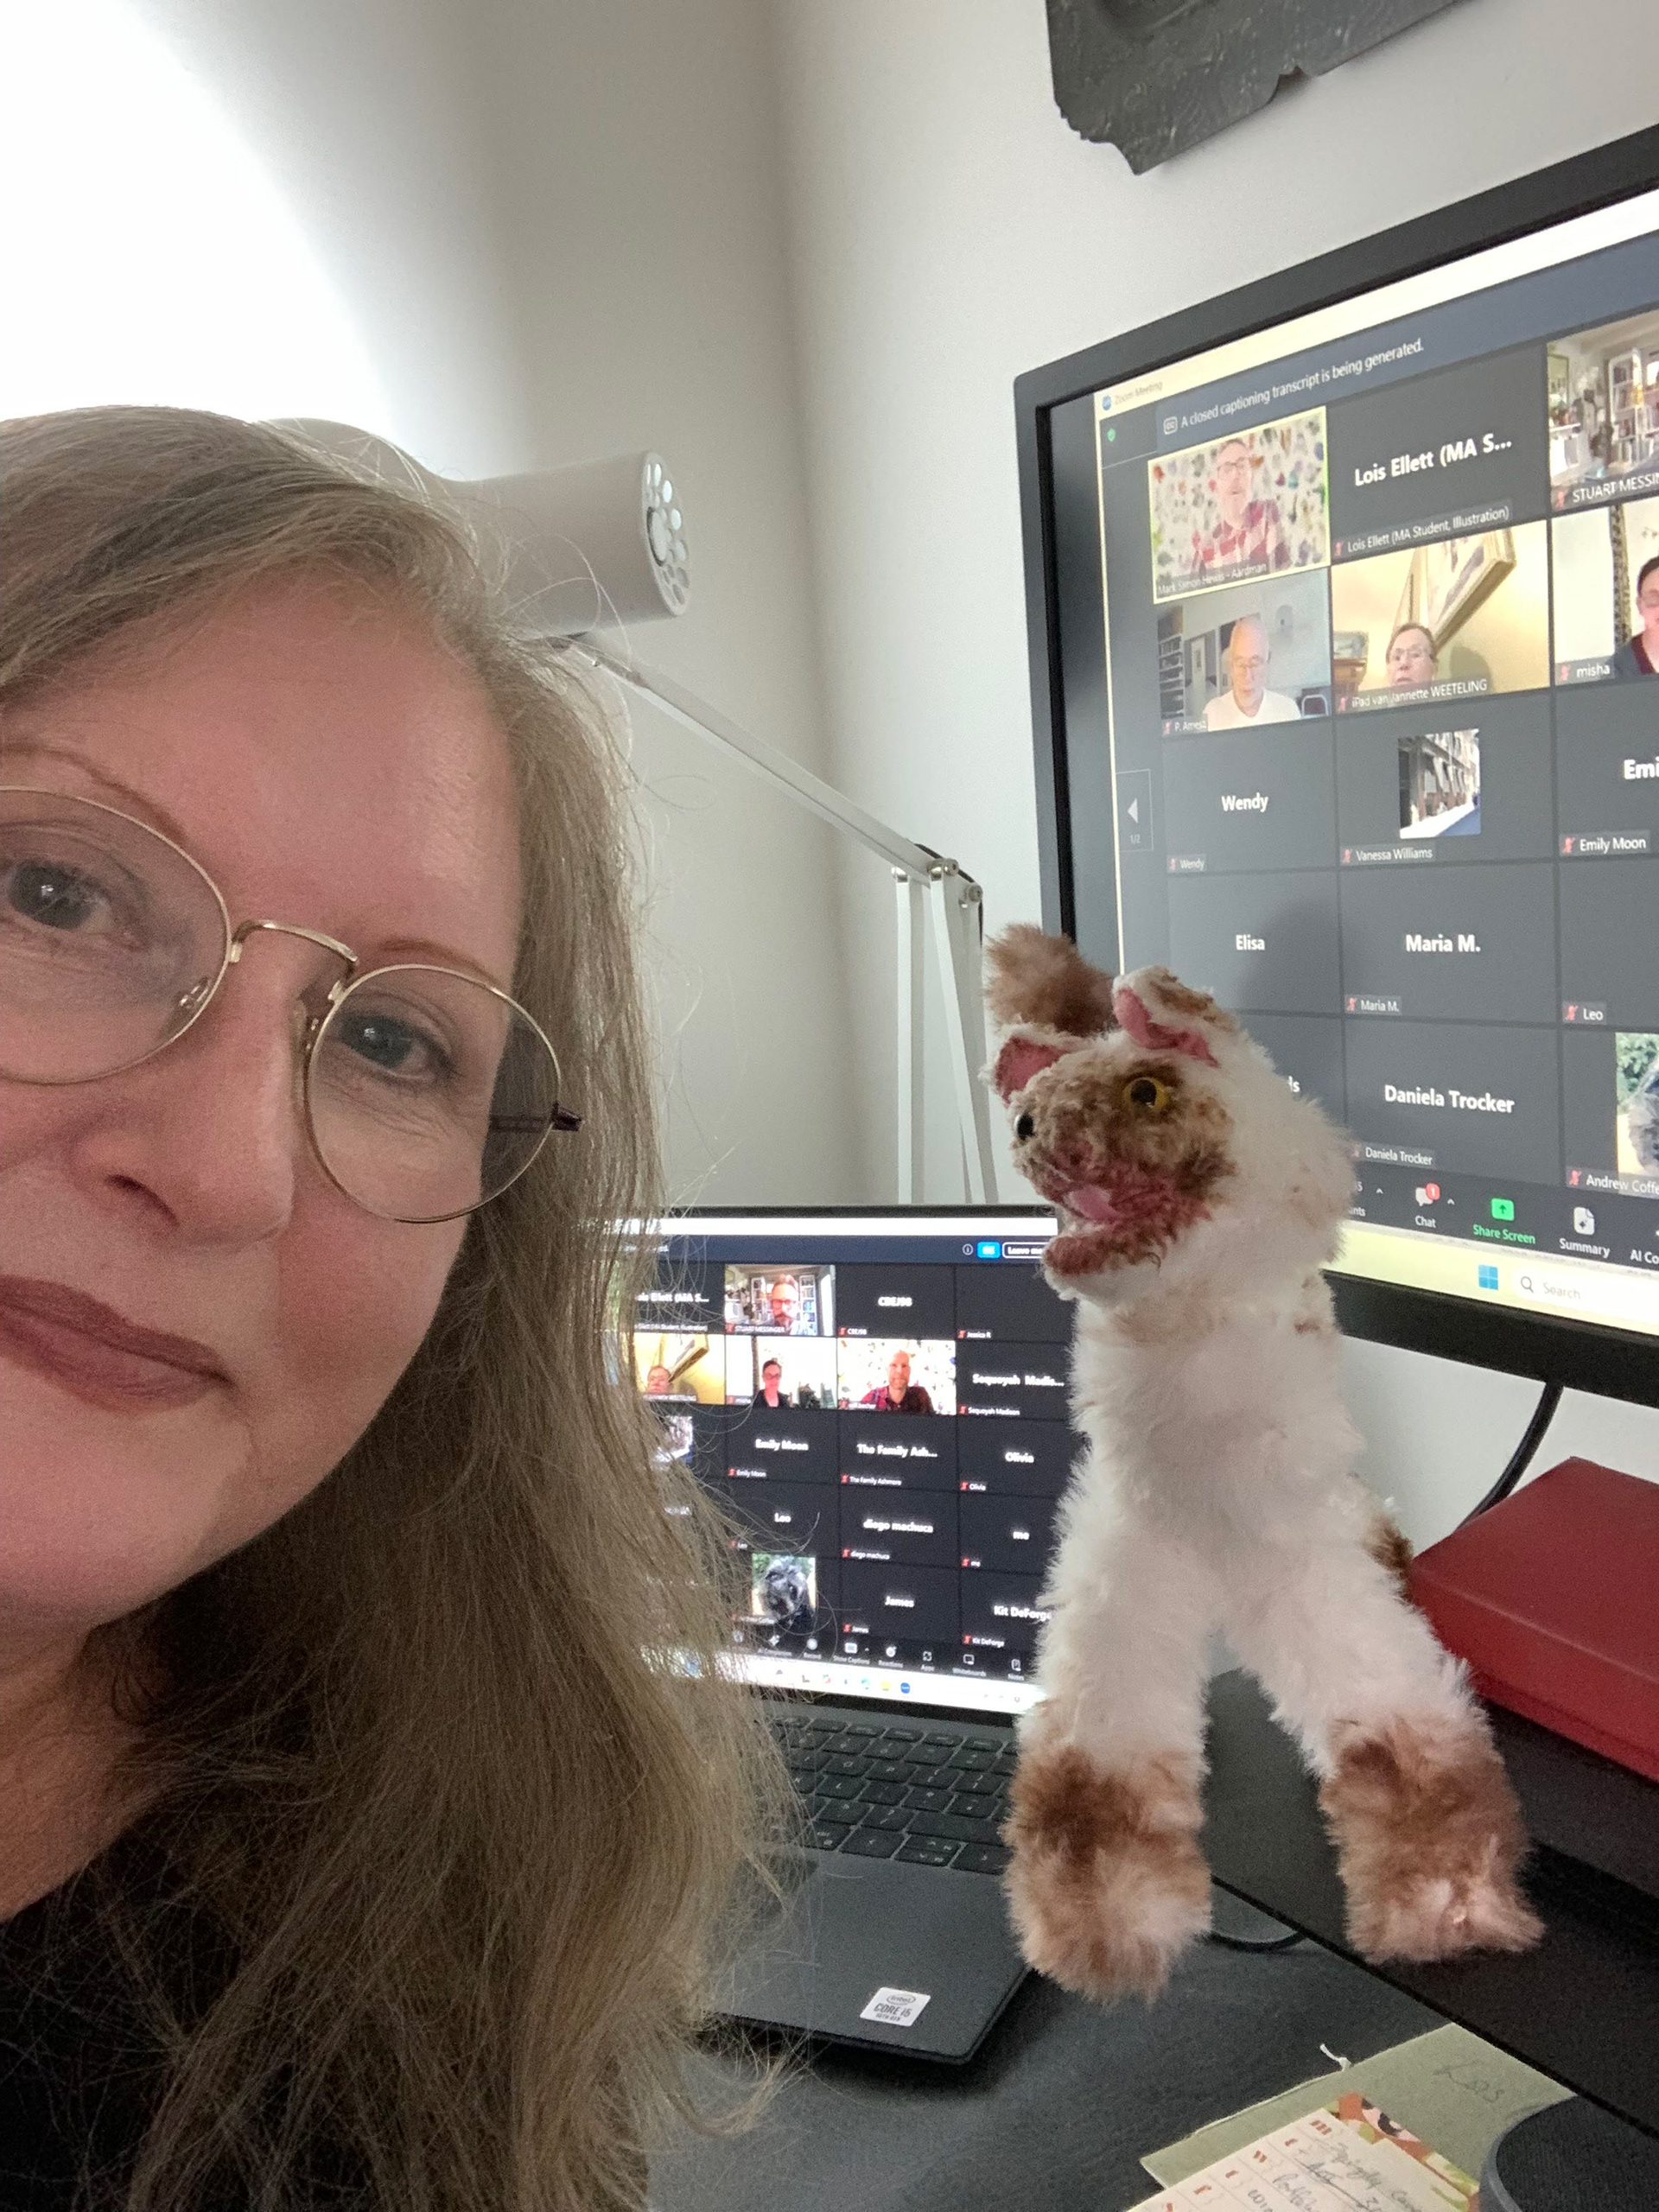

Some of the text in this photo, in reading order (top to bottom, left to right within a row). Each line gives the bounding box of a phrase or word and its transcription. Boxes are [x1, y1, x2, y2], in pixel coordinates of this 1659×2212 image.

[1180, 416, 1190, 429] A
[1189, 405, 1219, 426] closed
[1220, 391, 1270, 421] captioning
[1272, 372, 1320, 401] transcript
[1321, 369, 1331, 383] is
[1332, 359, 1363, 381] being
[1364, 339, 1425, 374] generated.
[1354, 433, 1512, 486] Lois Ellett (MA S...
[1573, 482, 1617, 504] STUART
[1347, 539, 1366, 553] Lois
[1367, 534, 1389, 549] Ellett
[1391, 528, 1412, 546] (MA
[1452, 504, 1510, 530] Illustration)
[1575, 662, 1611, 679] misha
[1430, 678, 1488, 698] WEETELING
[1221, 792, 1269, 813] Wendy
[1580, 836, 1647, 855] Emily Moon
[1356, 847, 1433, 862] Vanessa Williams
[1179, 858, 1205, 872] Wendy
[1235, 934, 1266, 950] Elisa
[1405, 933, 1481, 952] Maria M.
[1360, 999, 1400, 1013] Maria M.
[1583, 1007, 1604, 1021] Leo
[1384, 1084, 1516, 1114] Daniela Trocker
[1365, 1147, 1433, 1166] Daniela Trocker
[1586, 1174, 1629, 1191] Andrew
[1414, 1215, 1437, 1229] Chat
[1472, 1224, 1536, 1244] Share Screen
[1559, 1238, 1611, 1258] Summary
[1630, 1249, 1643, 1262] AI
[1542, 1281, 1581, 1300] Search
[754, 1438, 810, 1452] Emily Moon
[856, 1442, 875, 1455] The
[877, 1444, 909, 1459] Family
[1004, 1448, 1035, 1464] Olivia
[774, 1512, 791, 1524] Leo
[884, 1595, 916, 1608] James
[994, 1605, 1009, 1617] Kit
[873, 2003, 901, 2015] CORE
